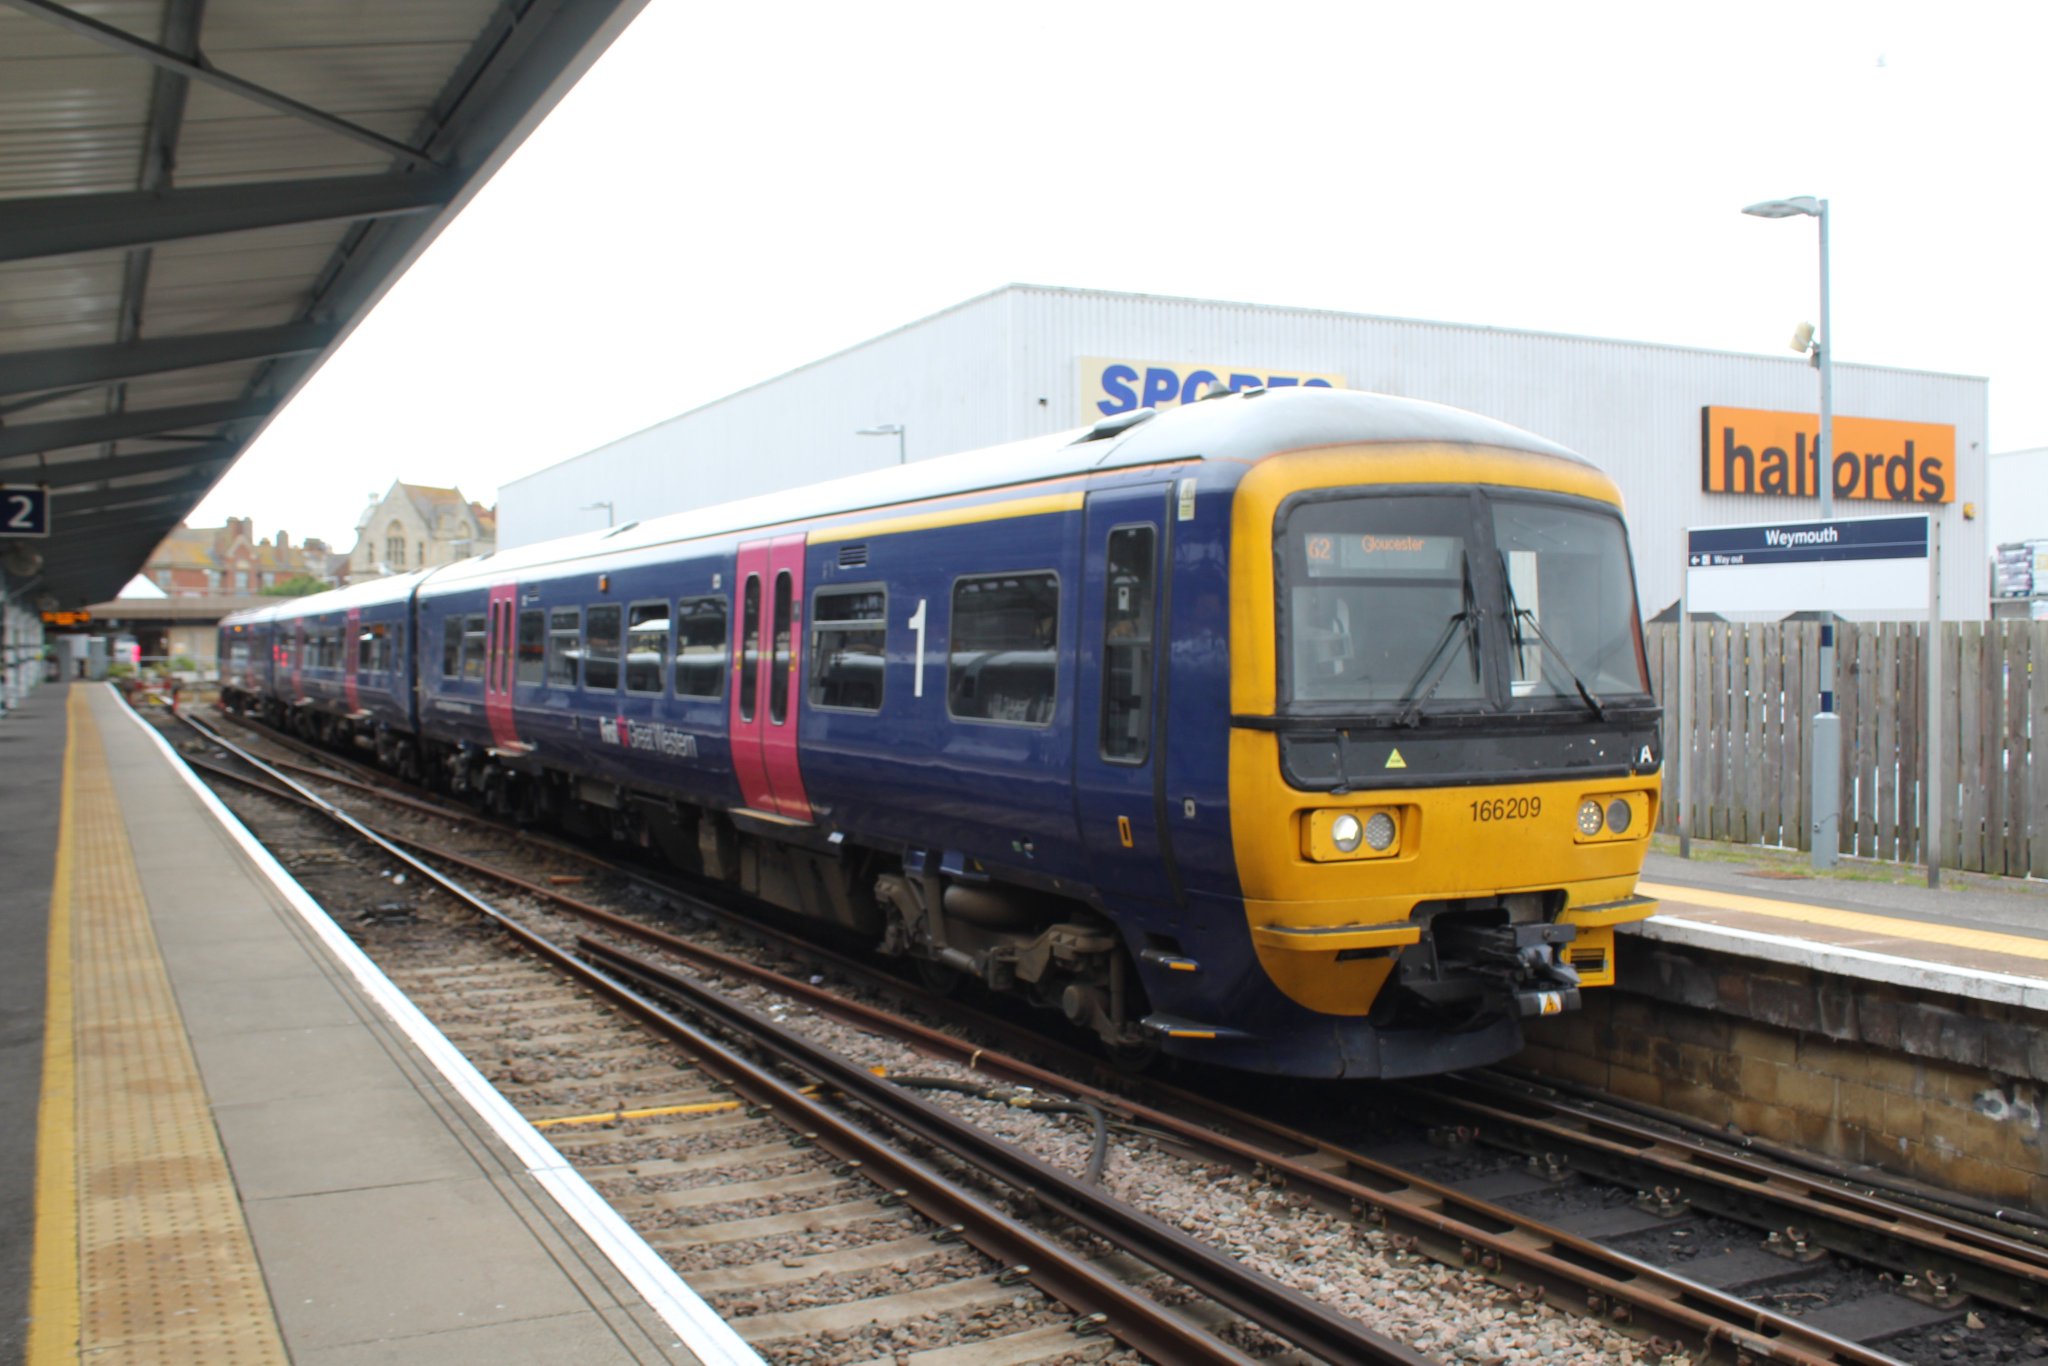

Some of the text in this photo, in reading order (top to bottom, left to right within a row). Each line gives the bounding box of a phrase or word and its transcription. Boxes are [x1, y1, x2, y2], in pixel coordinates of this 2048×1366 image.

[1096, 364, 1333, 416] SPO
[8, 495, 34, 528] 2
[1361, 534, 1425, 553] Gloucester
[1765, 527, 1838, 548] Weymouth
[1714, 555, 1743, 565] Way out
[908, 599, 926, 697] 1
[627, 719, 656, 751] Great
[654, 722, 698, 758] Western
[1640, 745, 1653, 763] A
[1470, 796, 1542, 822] 166209
